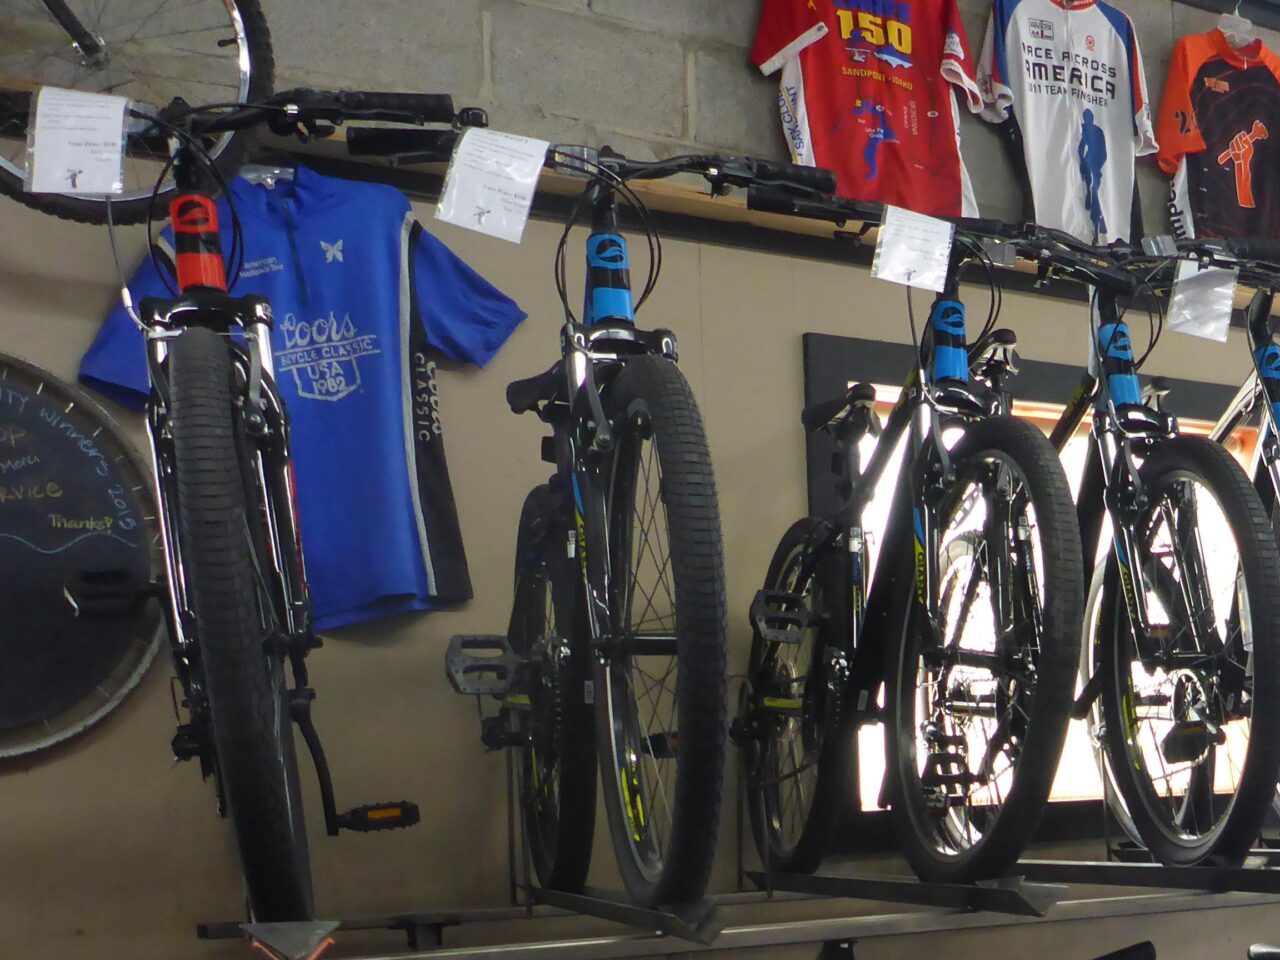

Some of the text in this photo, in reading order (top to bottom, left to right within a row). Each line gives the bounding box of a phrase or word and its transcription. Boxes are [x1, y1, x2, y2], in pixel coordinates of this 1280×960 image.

[837, 9, 912, 55] 150
[280, 311, 357, 349] Coors
[322, 340, 373, 356] CLASSIC
[307, 360, 344, 379] USA
[312, 376, 348, 395] 1982
[415, 353, 431, 442] CLASSIC
[108, 484, 137, 530] 2015
